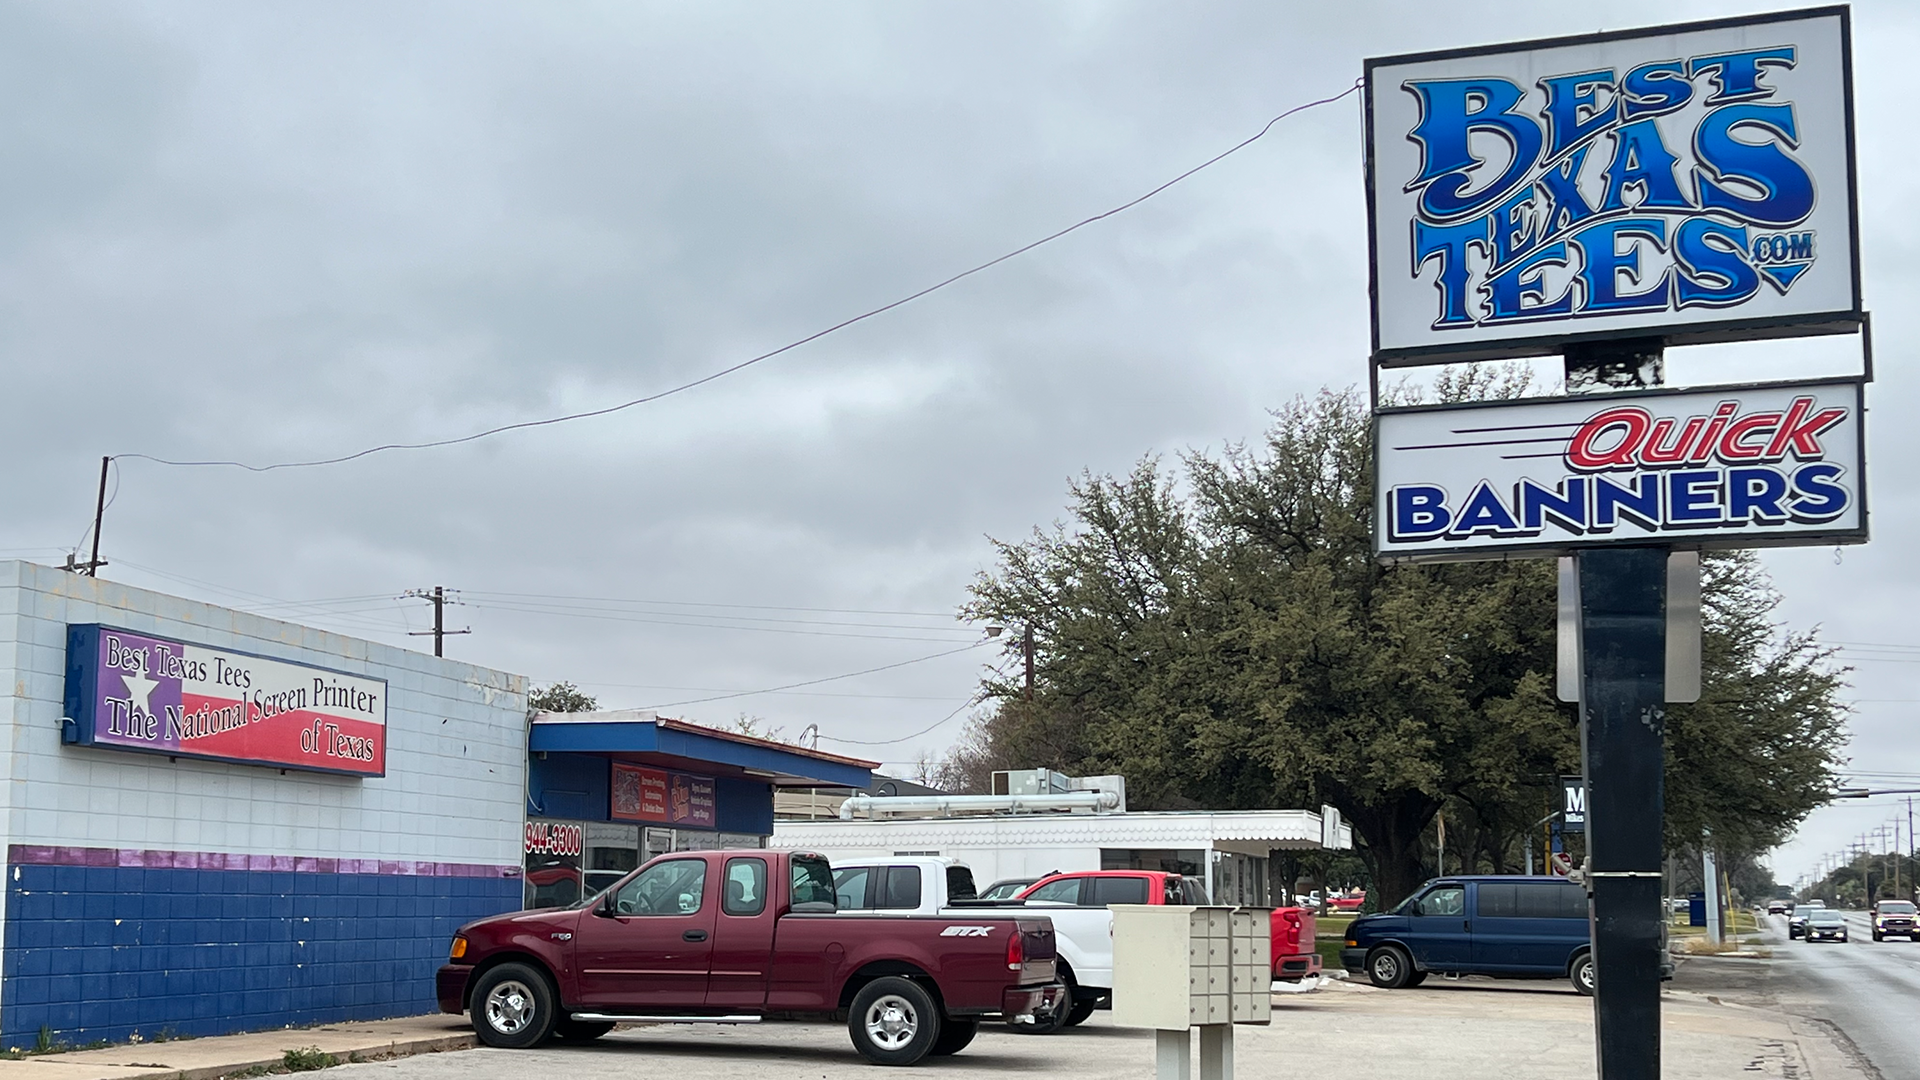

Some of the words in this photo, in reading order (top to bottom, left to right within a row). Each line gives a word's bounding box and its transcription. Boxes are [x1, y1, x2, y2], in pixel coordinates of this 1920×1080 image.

[1402, 45, 1798, 222] BEST
[1412, 102, 1818, 278] TEXAS
[1411, 213, 1762, 331] TEES
[1565, 397, 1848, 471] Quick
[1388, 463, 1851, 541] BANNERS
[107, 637, 149, 672] Best
[156, 645, 207, 681] Texas
[214, 657, 251, 688] Tees
[105, 697, 157, 740] The
[166, 692, 248, 740] National
[252, 688, 307, 722] Screen
[313, 678, 377, 714] Printer
[301, 719, 320, 753] of
[326, 723, 374, 761] Texas
[525, 821, 581, 856] 944-3300
